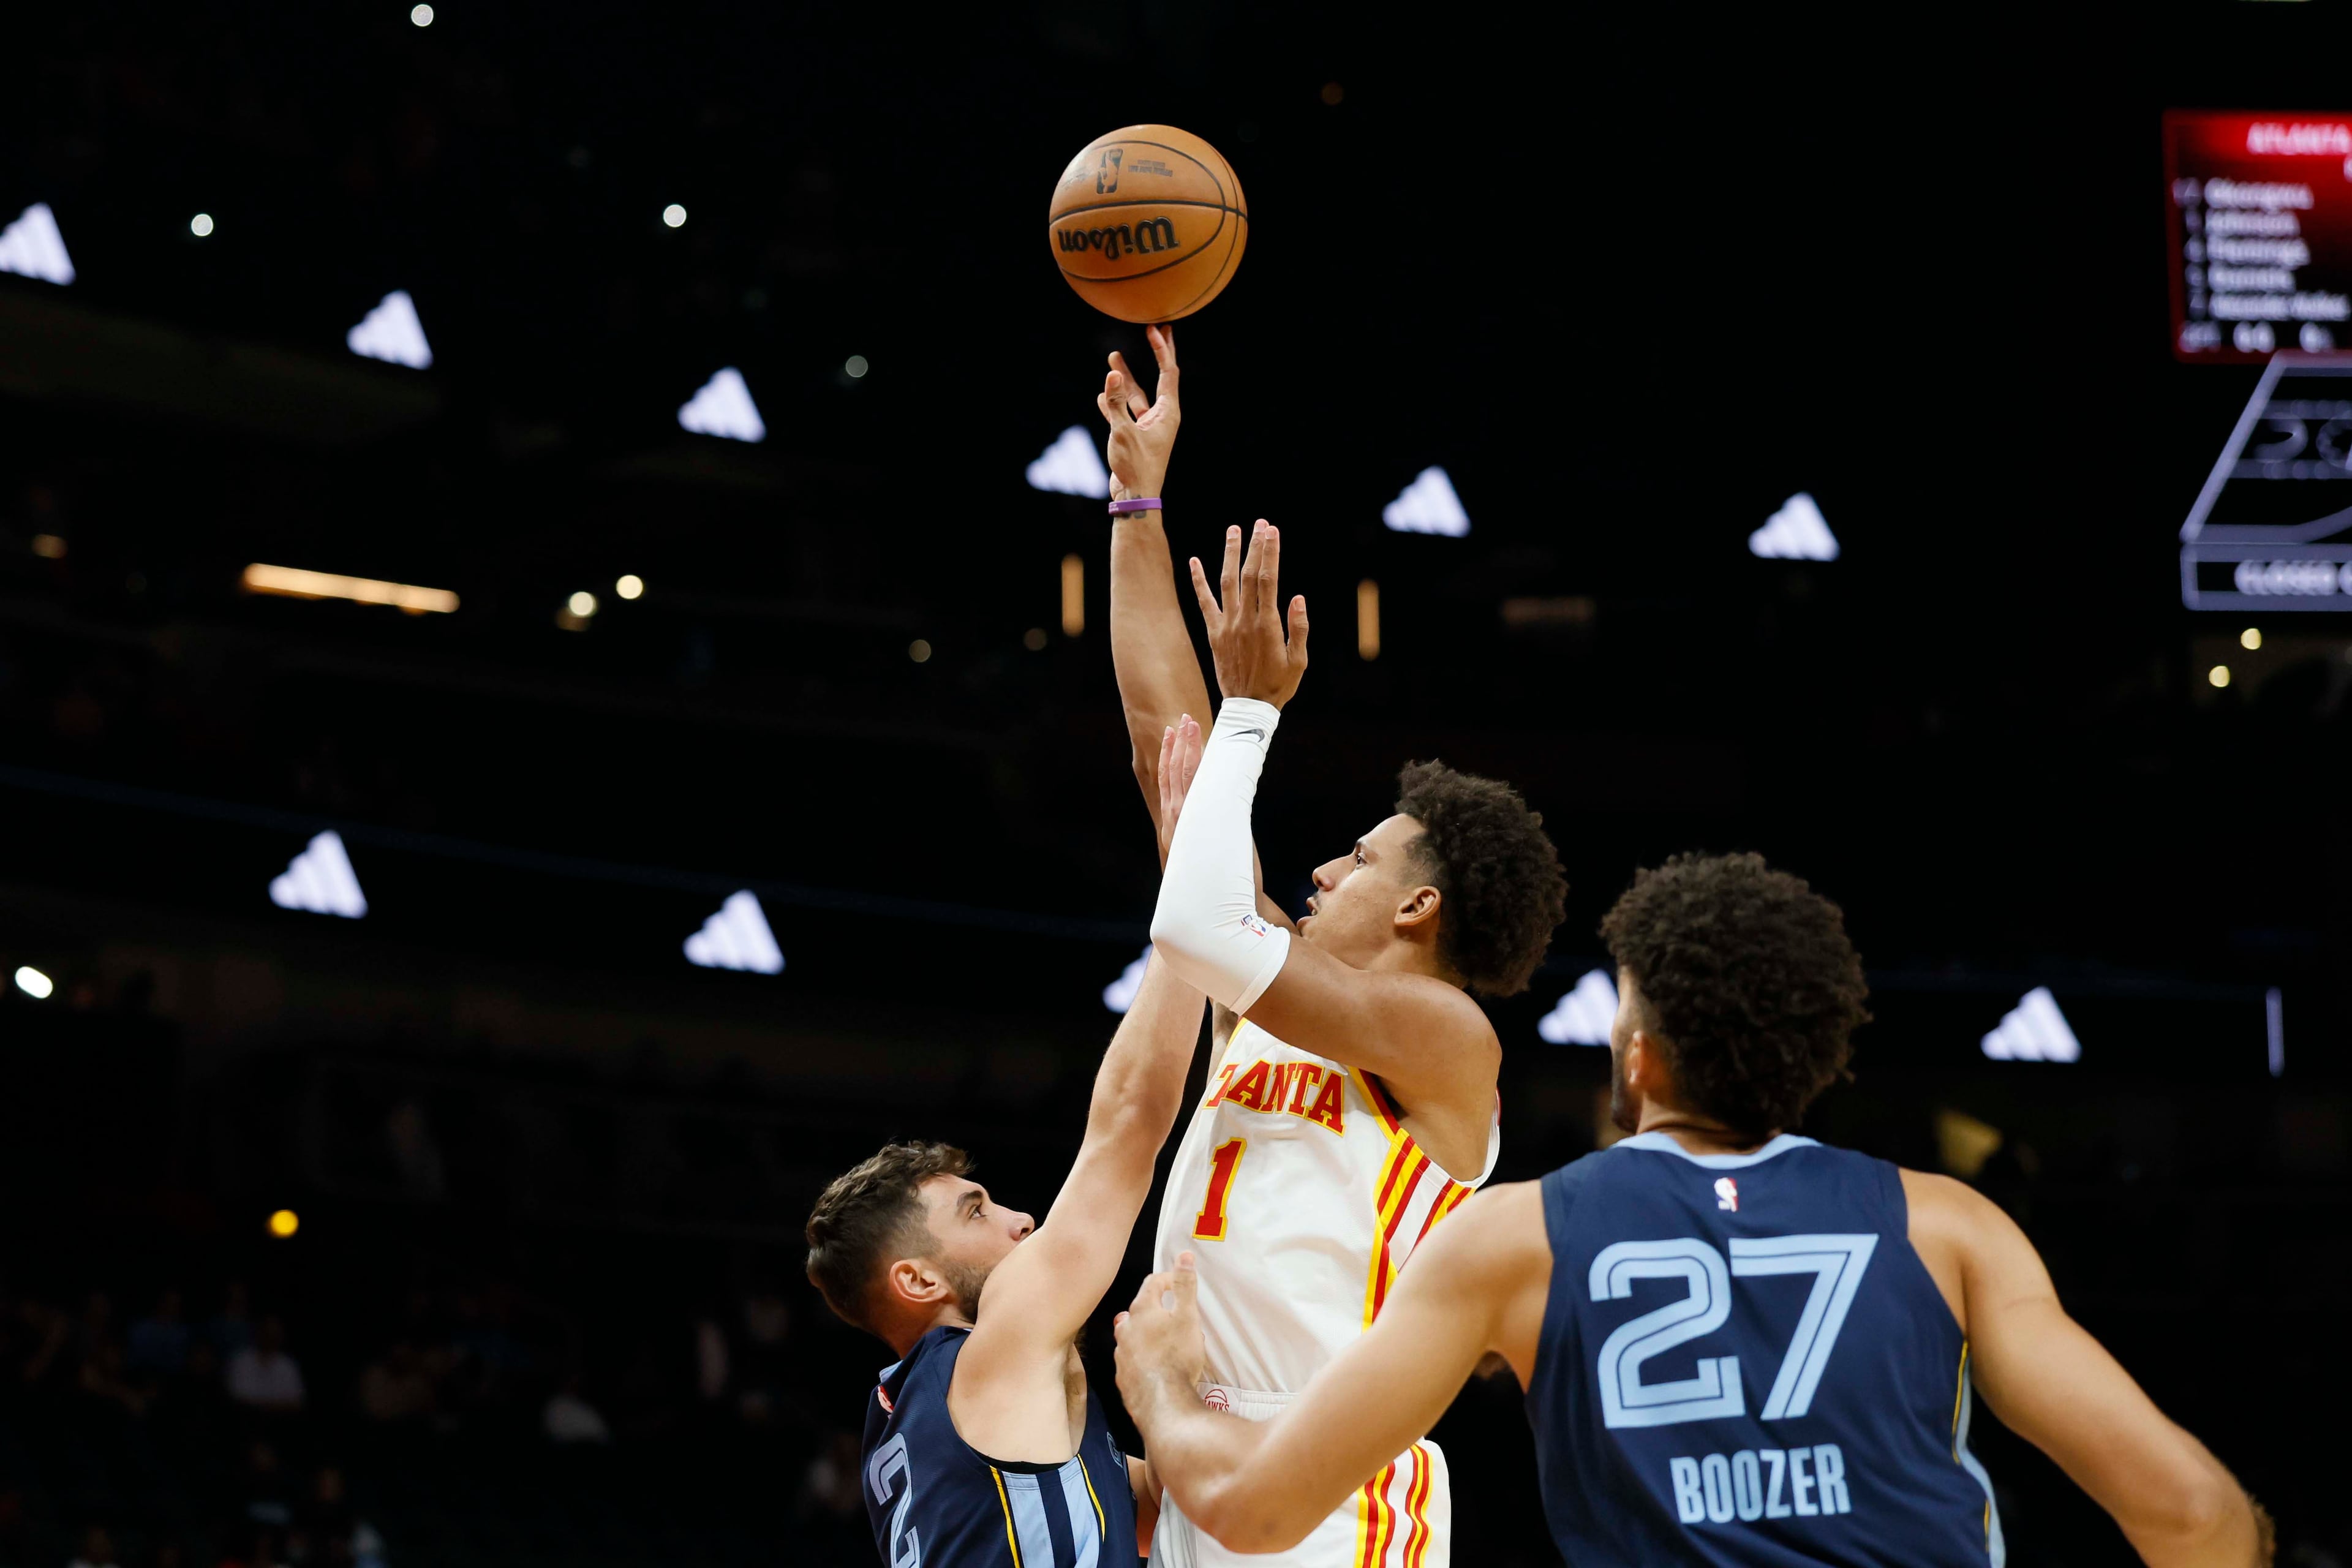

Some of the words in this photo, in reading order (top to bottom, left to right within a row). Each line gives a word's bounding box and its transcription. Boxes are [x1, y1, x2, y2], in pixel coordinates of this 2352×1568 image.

[1057, 216, 1180, 260] Wilson
[1192, 1137, 1247, 1241] 1
[1589, 1233, 1879, 1429] 27
[1204, 1400, 1230, 1414] AWKS
[1670, 1443, 1851, 1524] BOOZER
